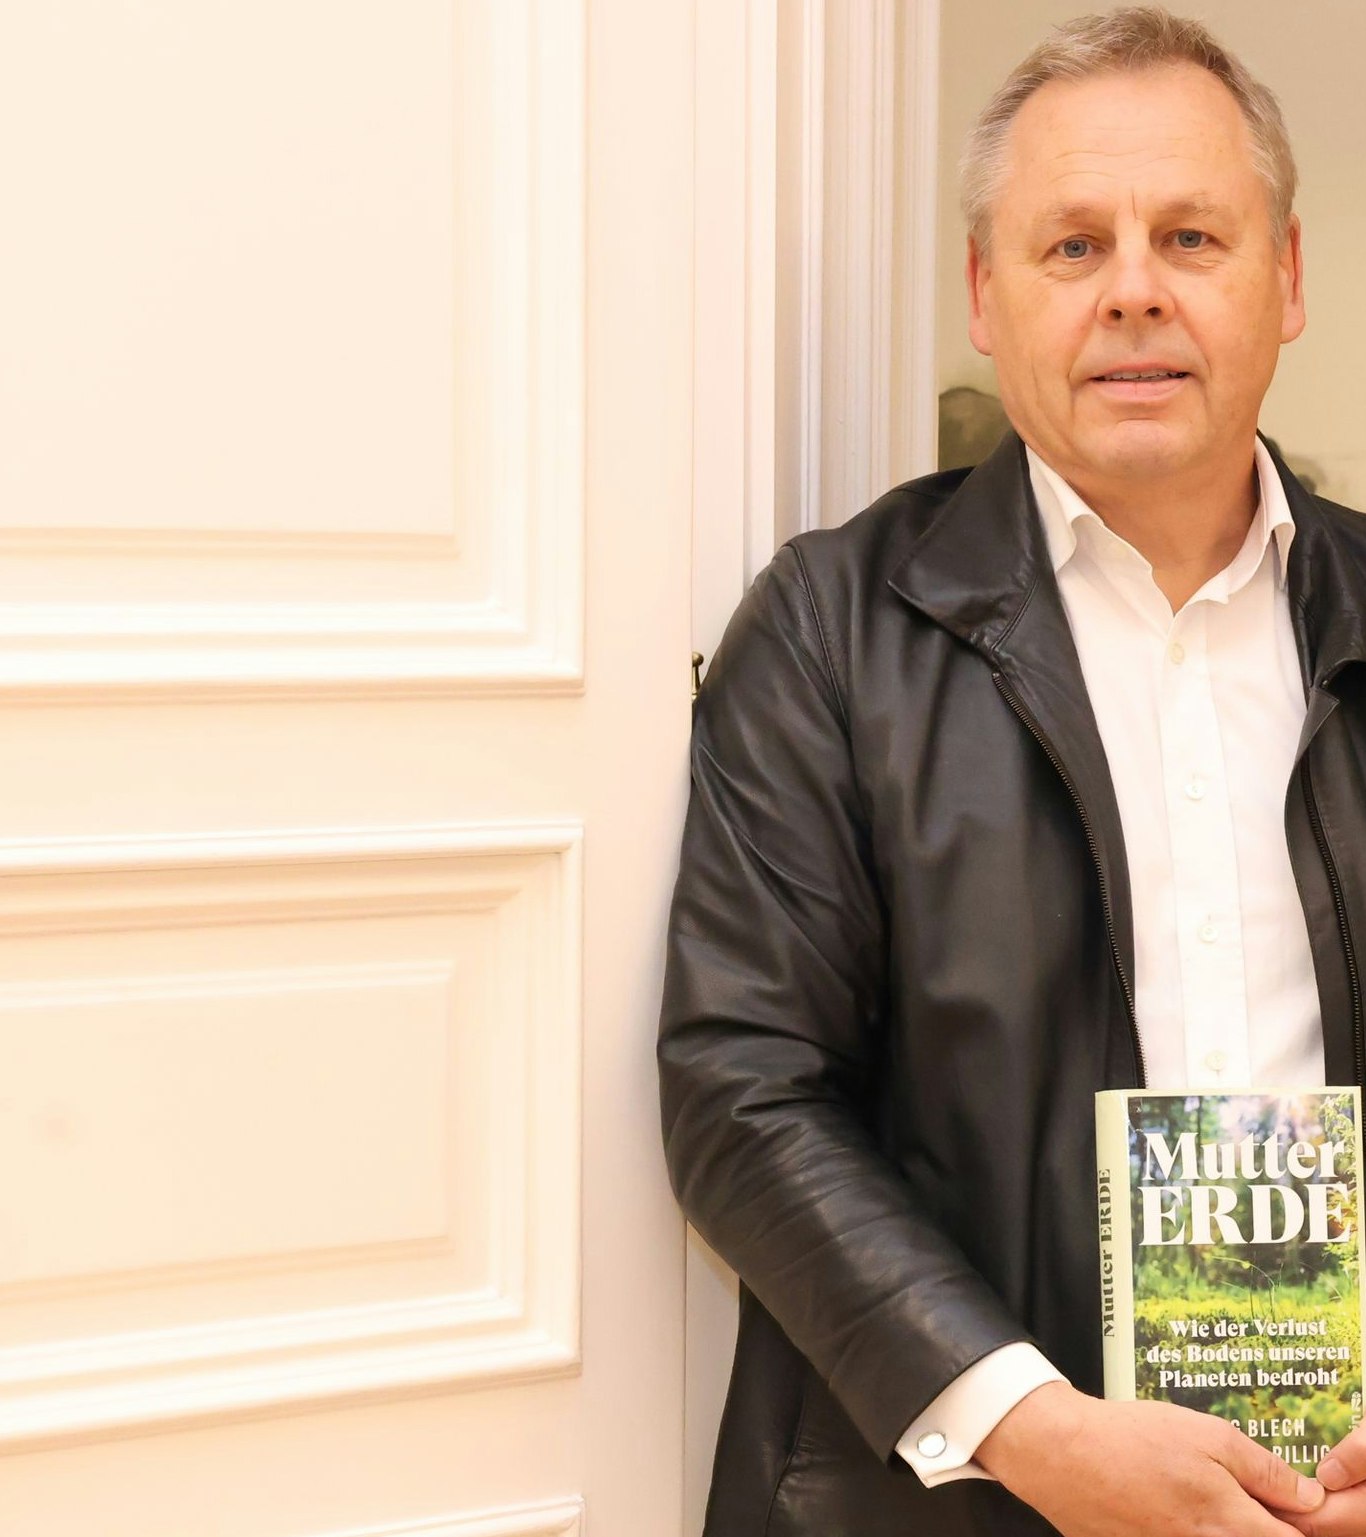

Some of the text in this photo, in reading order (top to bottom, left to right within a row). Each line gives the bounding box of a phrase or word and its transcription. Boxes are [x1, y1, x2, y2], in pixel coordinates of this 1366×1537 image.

[1142, 1131, 1345, 1181] Mutter
[1138, 1183, 1351, 1246] ERDE
[1099, 1169, 1115, 1337] Mutter ERDE
[1168, 1318, 1327, 1338] Wie der Verlust
[1146, 1344, 1350, 1364] des Bodens unseren
[1159, 1367, 1339, 1389] Planeten bedroht
[1248, 1418, 1305, 1438] BLECH
